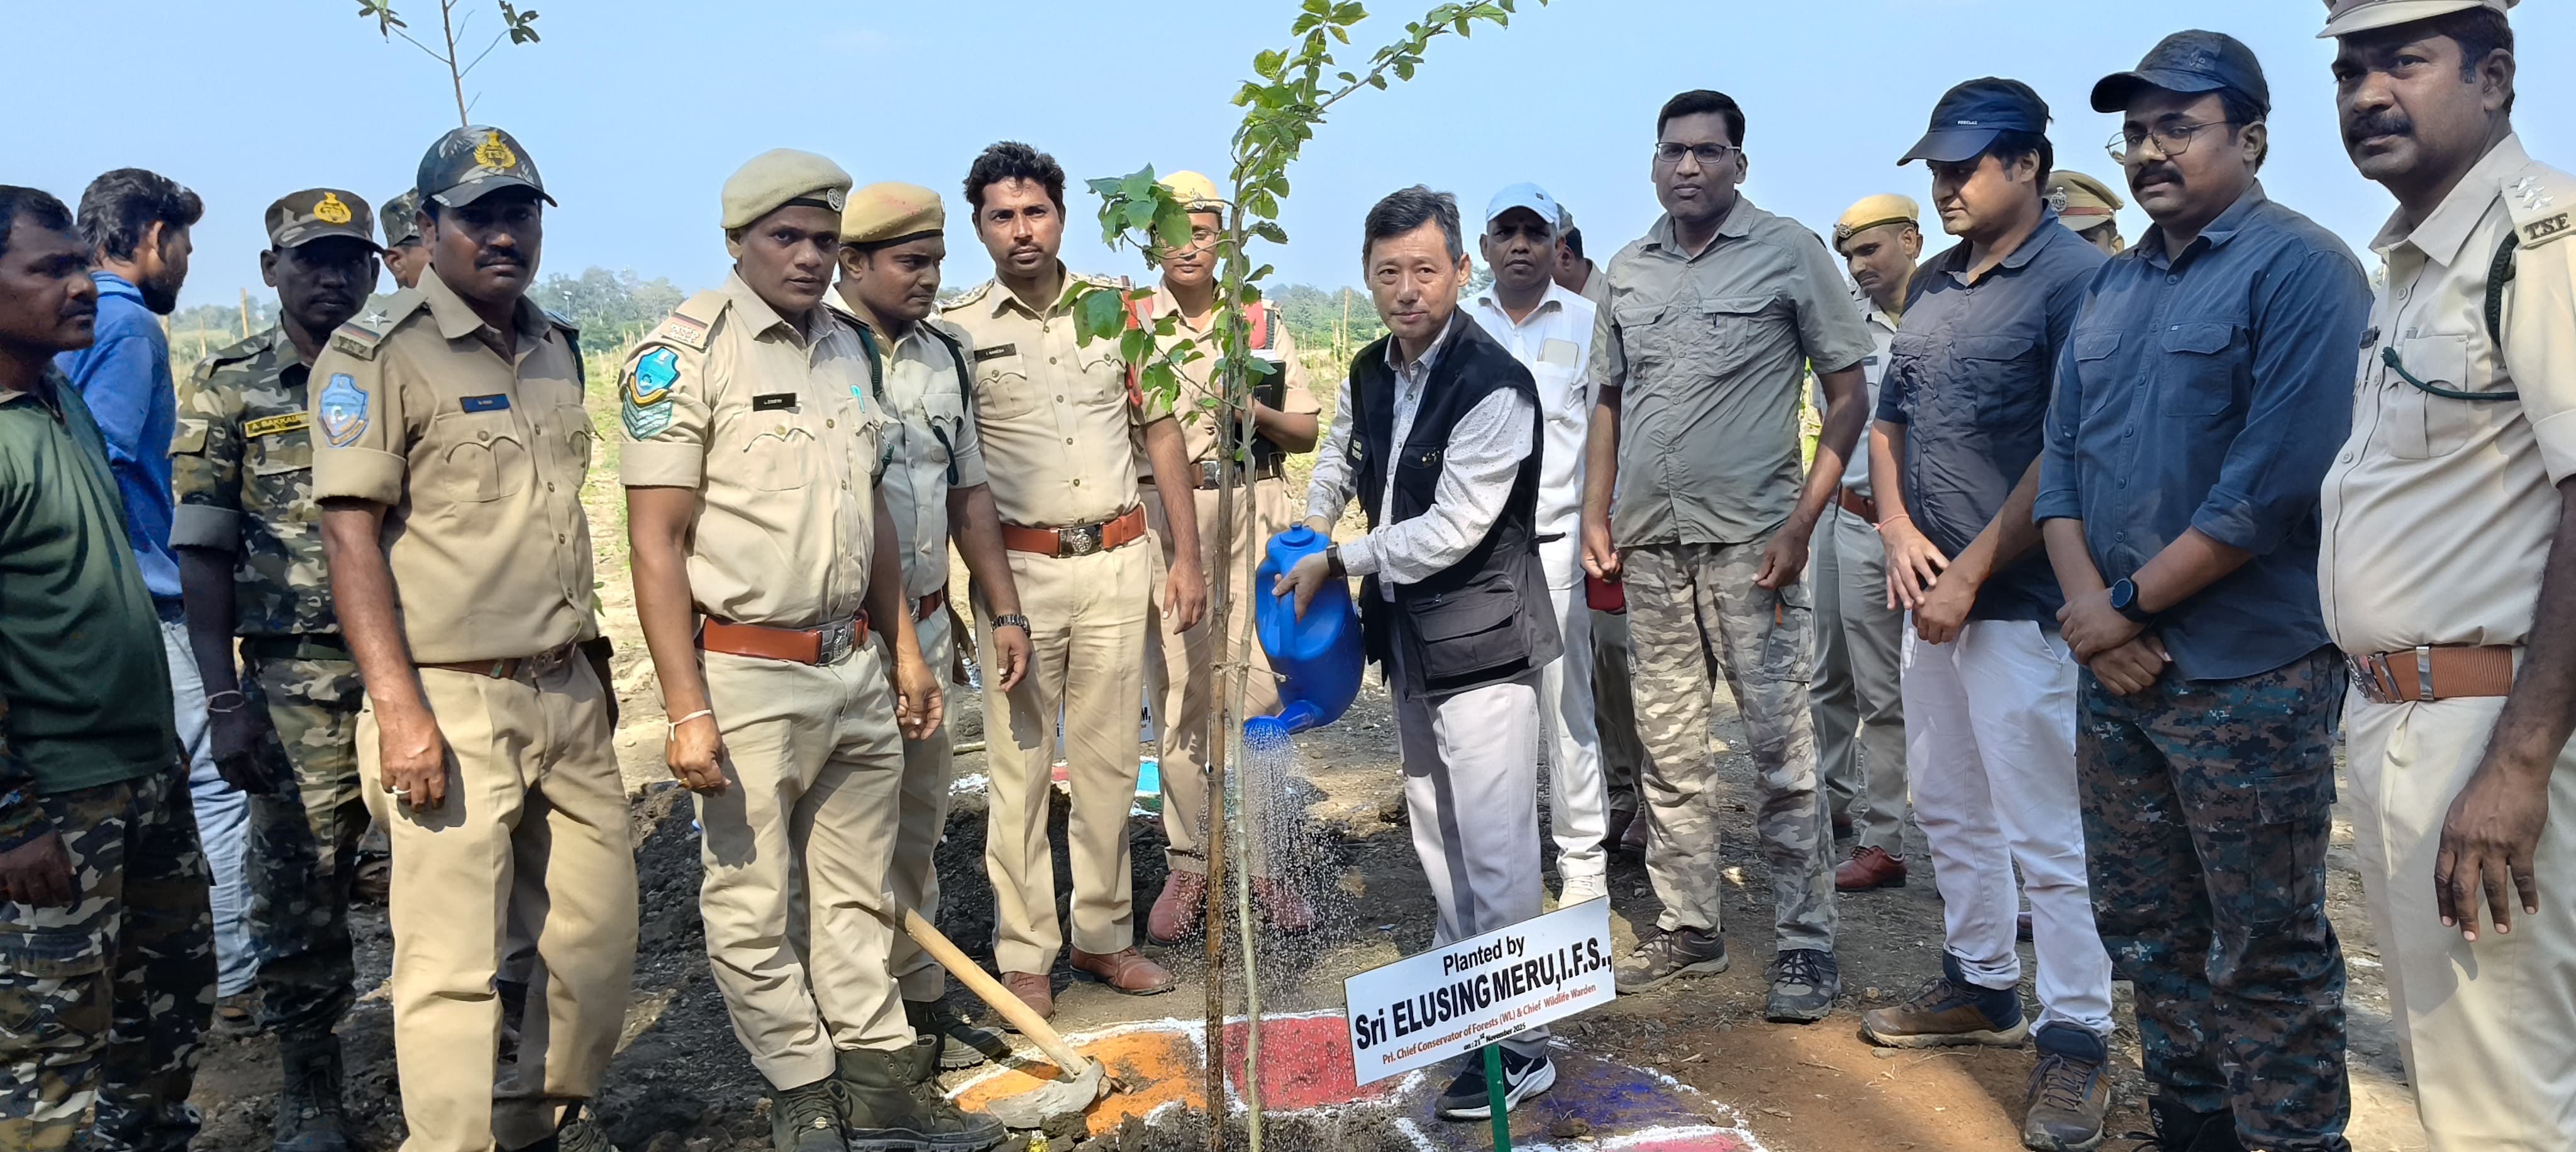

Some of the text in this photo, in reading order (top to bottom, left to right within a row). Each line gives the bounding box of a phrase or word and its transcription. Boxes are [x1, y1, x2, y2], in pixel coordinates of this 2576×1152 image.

[1443, 935, 1525, 976] Planted by
[1355, 1007, 1387, 1050] Sri
[1392, 974, 1491, 1038] ELUSING
[1382, 984, 1596, 1064] Prl. Chief Conservator of Forests (WL) & Chief Wildlife Warden
[1485, 1028, 1513, 1043] November
[1513, 1022, 1526, 1033] 2025
